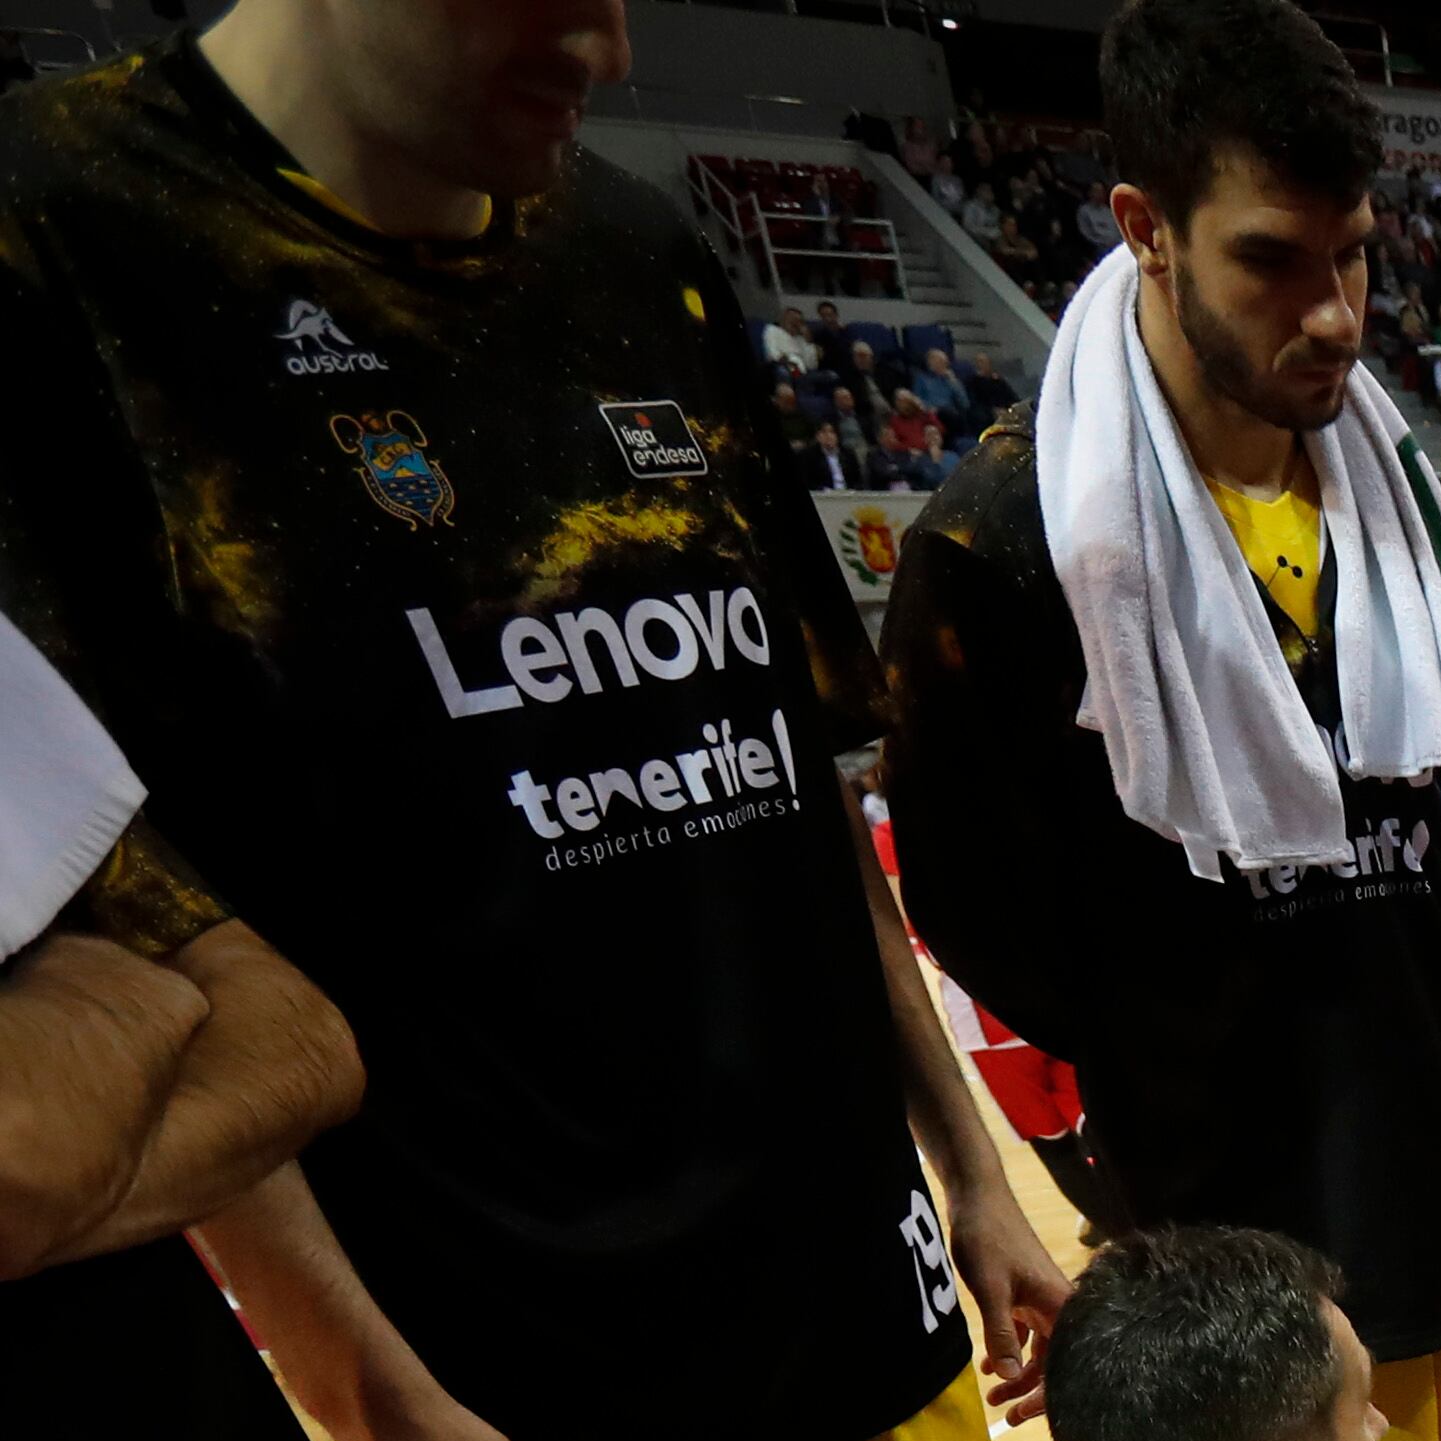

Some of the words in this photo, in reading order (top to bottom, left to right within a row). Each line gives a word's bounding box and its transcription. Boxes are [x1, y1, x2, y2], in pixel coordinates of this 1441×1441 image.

[619, 423, 656, 446] liga
[632, 446, 700, 468] endesa
[405, 586, 770, 719] Lenovo
[545, 822, 672, 873] despierta
